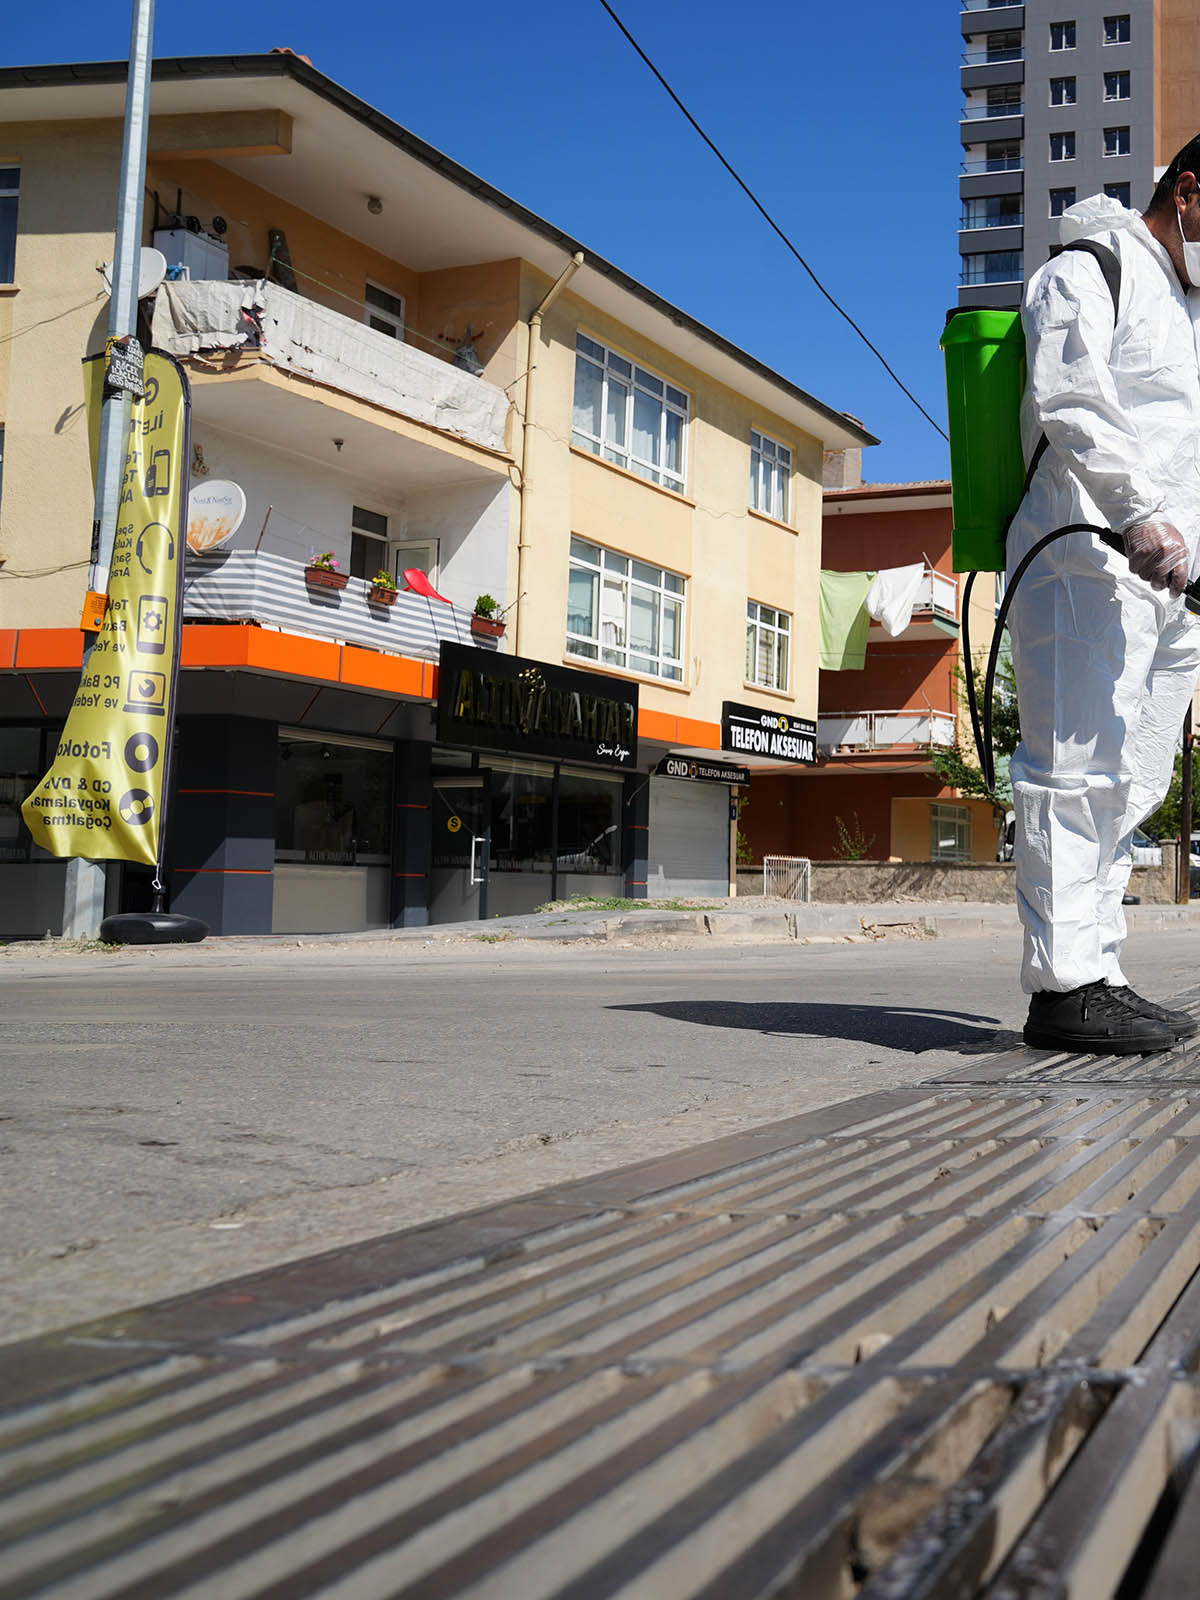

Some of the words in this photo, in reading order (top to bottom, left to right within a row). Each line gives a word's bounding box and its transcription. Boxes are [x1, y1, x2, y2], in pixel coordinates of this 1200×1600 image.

[760, 714, 779, 730] GND
[730, 724, 769, 753] TELEFON
[770, 733, 814, 762] AKSESUAR
[666, 760, 688, 776] GND
[699, 767, 720, 778] TELEFON
[721, 770, 745, 781] AKSESUAR
